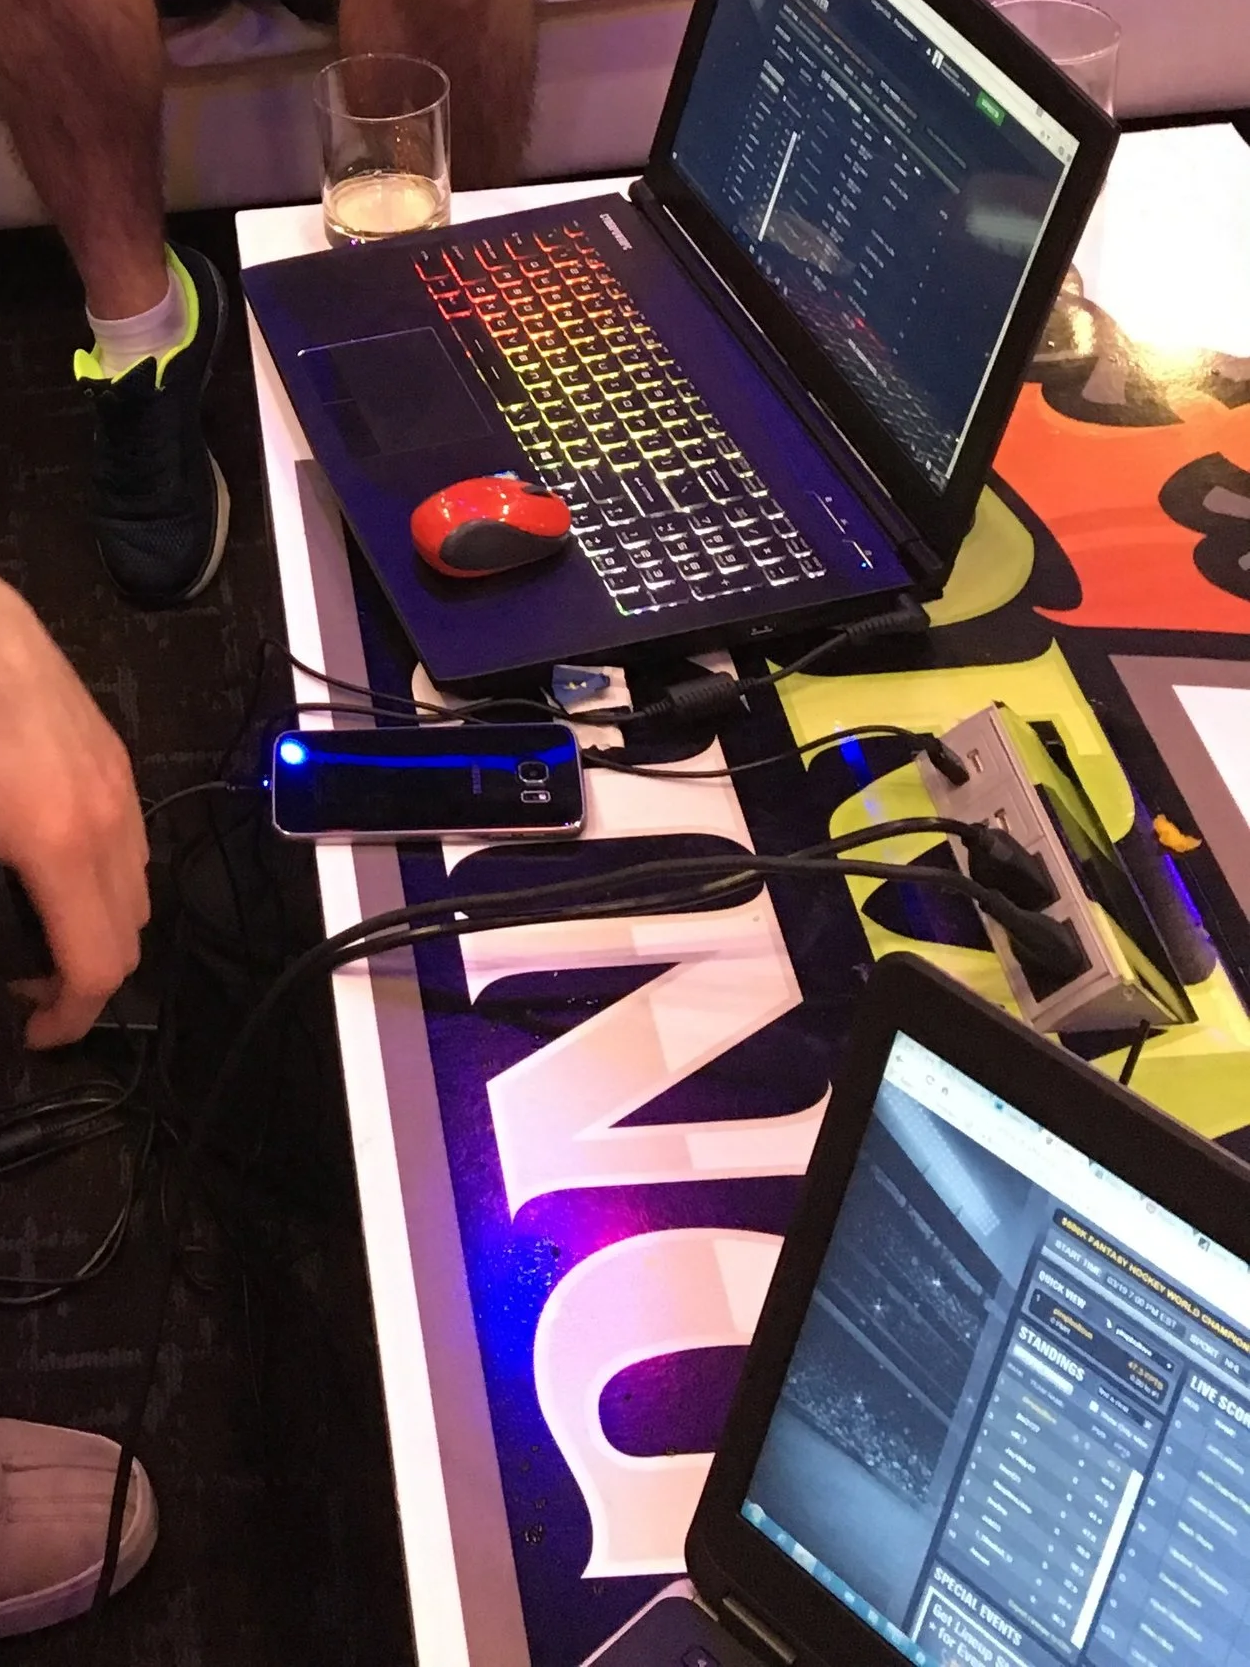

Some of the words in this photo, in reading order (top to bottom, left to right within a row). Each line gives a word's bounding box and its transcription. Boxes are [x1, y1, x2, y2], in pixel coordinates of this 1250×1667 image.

[1054, 1239, 1082, 1263] START
[1038, 1270, 1065, 1295] QUICK
[1065, 1287, 1087, 1310] VIEW
[1088, 1235, 1128, 1268] FANTASY
[1128, 1262, 1166, 1294] HOCKEY
[1166, 1288, 1200, 1318] WORLD
[1018, 1325, 1086, 1382] STANDINGS
[1190, 1375, 1218, 1404] LIVE
[934, 1567, 978, 1611] SPECIAL
[979, 1603, 1023, 1647] EVENTS
[953, 1621, 993, 1662] Lineup
